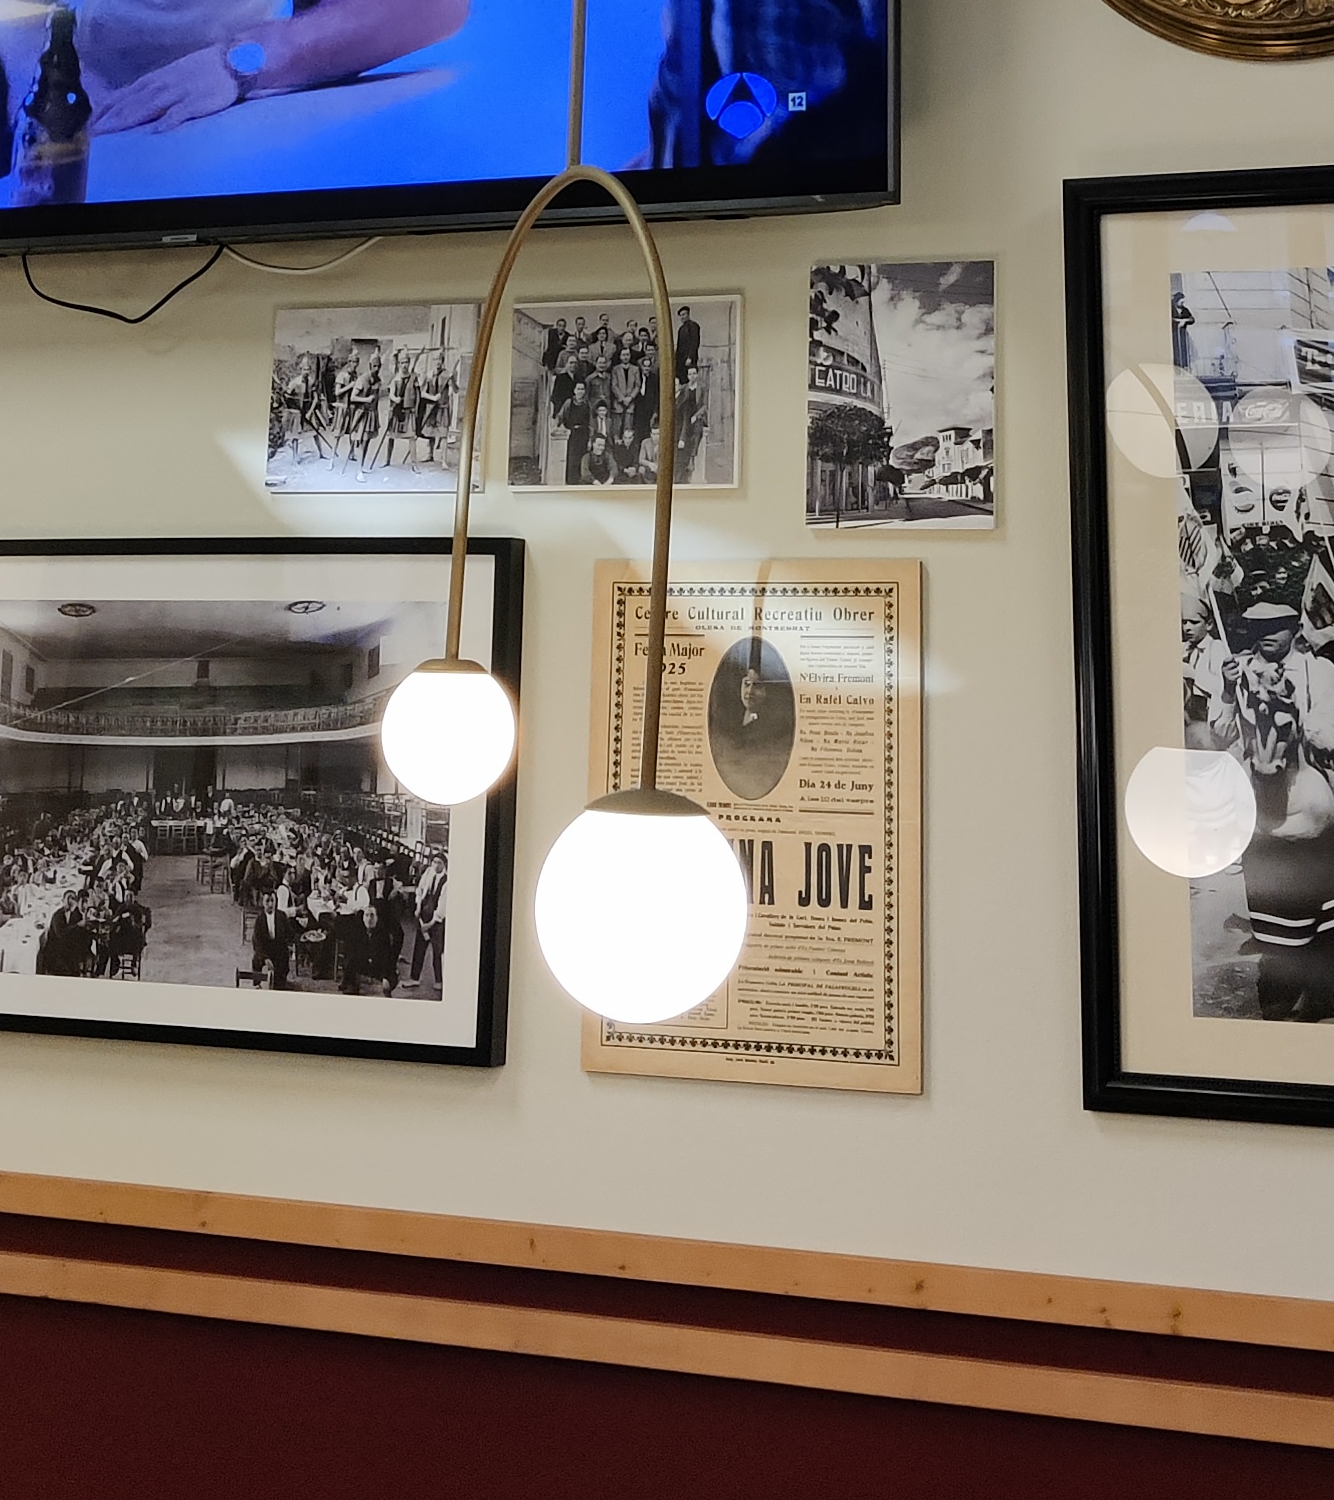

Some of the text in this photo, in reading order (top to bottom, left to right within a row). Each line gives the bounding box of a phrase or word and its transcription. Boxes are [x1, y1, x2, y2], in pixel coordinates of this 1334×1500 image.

[790, 95, 804, 107] 12
[635, 606, 874, 621] Cere Cultural Recreatiu Obrer
[635, 643, 705, 660] Fea Major
[661, 662, 686, 675] 925
[838, 673, 874, 683] Fremont
[799, 694, 874, 705] En Rafel Calvo
[799, 779, 874, 792] Dia 24 de Juny
[718, 814, 782, 823] PROGRAMA
[798, 842, 873, 910] JOVE
